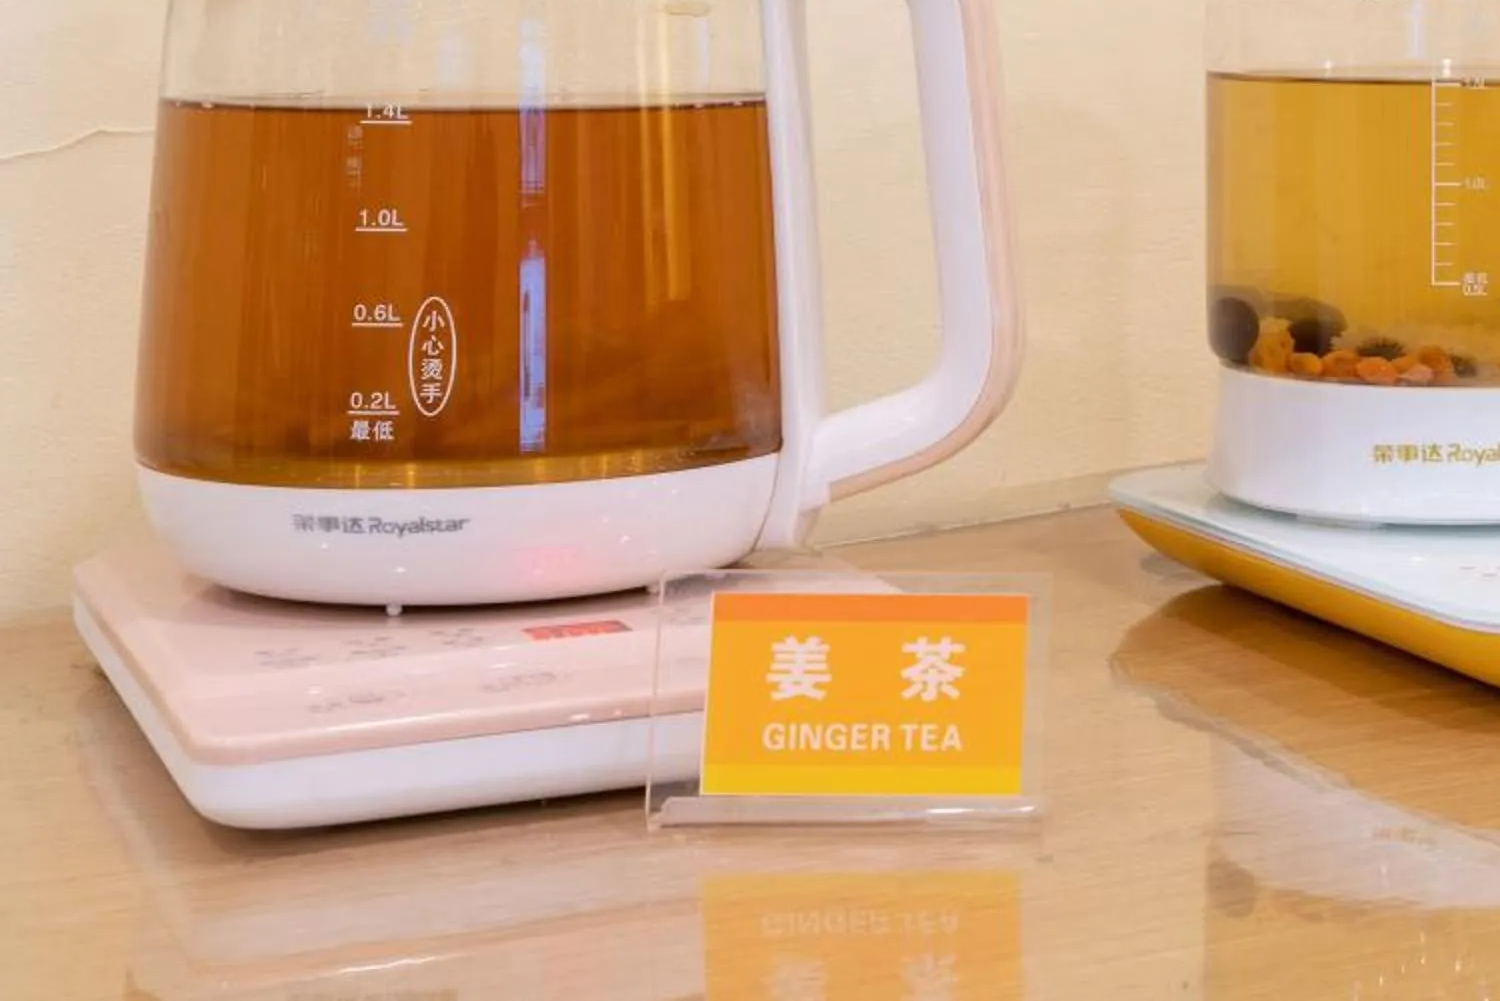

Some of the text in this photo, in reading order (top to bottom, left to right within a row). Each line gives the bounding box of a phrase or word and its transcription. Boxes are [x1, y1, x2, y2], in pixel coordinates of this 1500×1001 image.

[359, 208, 404, 228] 1.0L
[354, 304, 399, 322] 0.6L
[420, 310, 446, 405] 小心烫手
[350, 392, 397, 411] 0.2L
[350, 419, 395, 441] 最低
[368, 515, 471, 538] Royalstar
[766, 635, 966, 702] 姜茶
[762, 722, 963, 751] GINGER TEA
